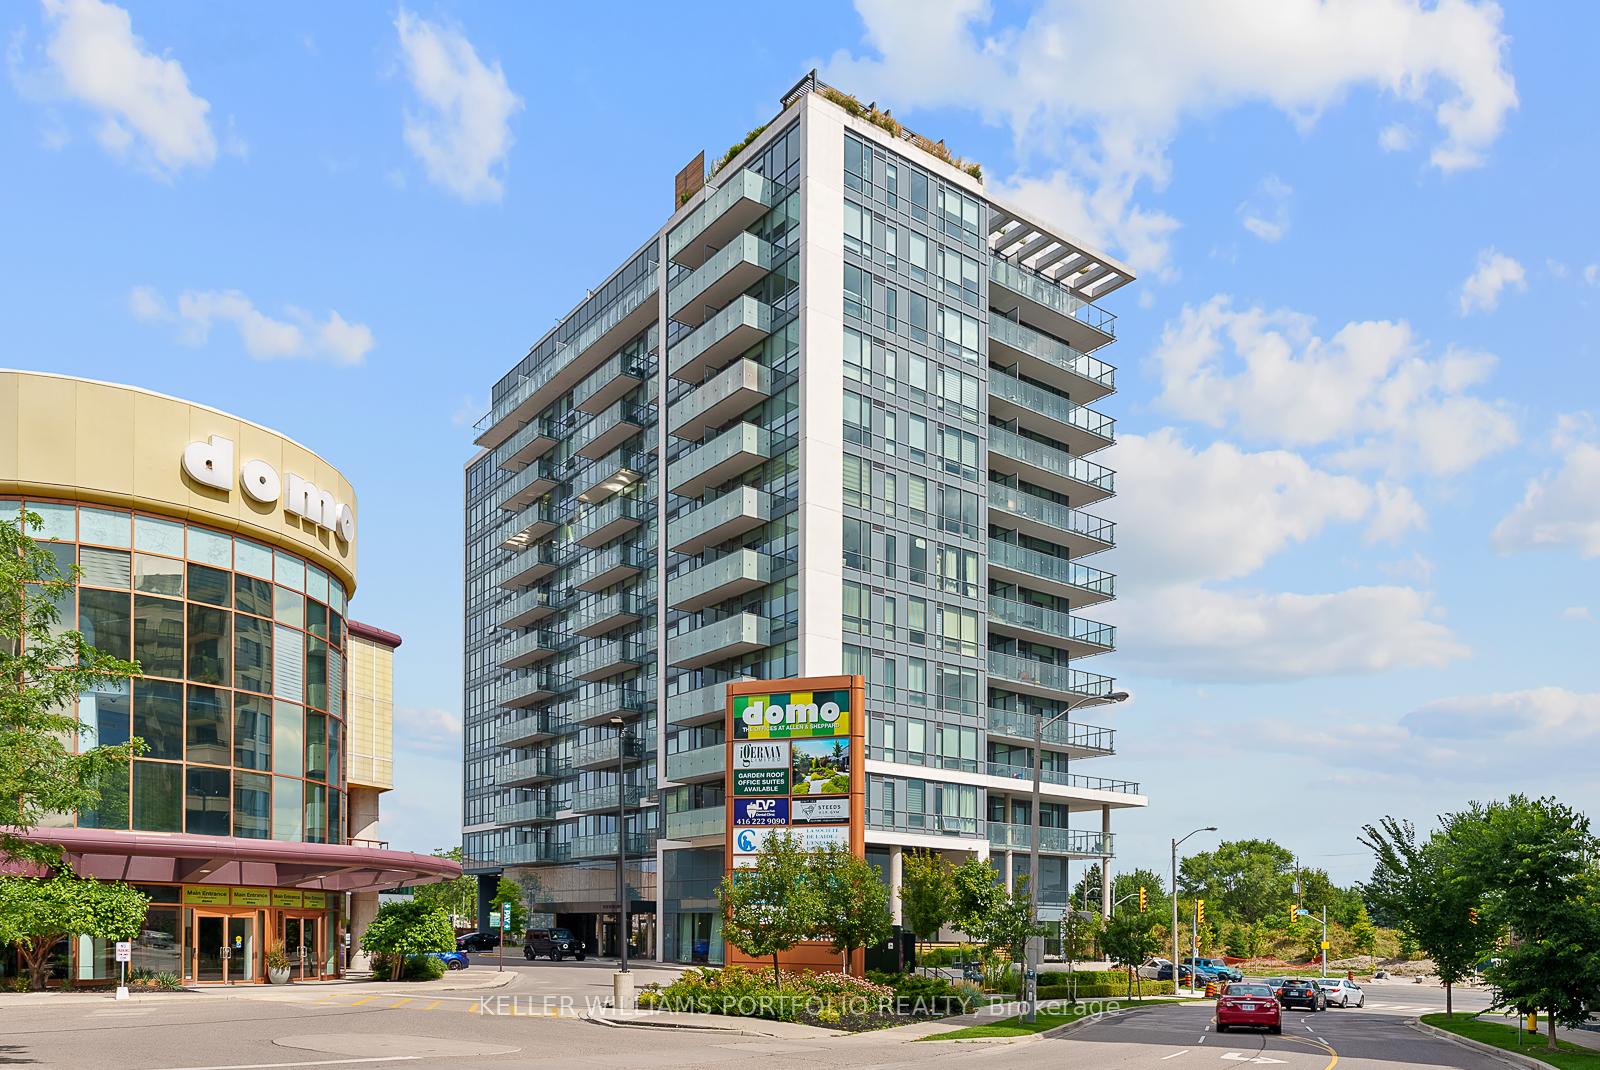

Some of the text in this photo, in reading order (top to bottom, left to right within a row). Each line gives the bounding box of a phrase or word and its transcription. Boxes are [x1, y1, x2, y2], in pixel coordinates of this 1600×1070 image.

[182, 434, 354, 544] domo
[742, 701, 840, 725] domo
[766, 817, 786, 825] 9090
